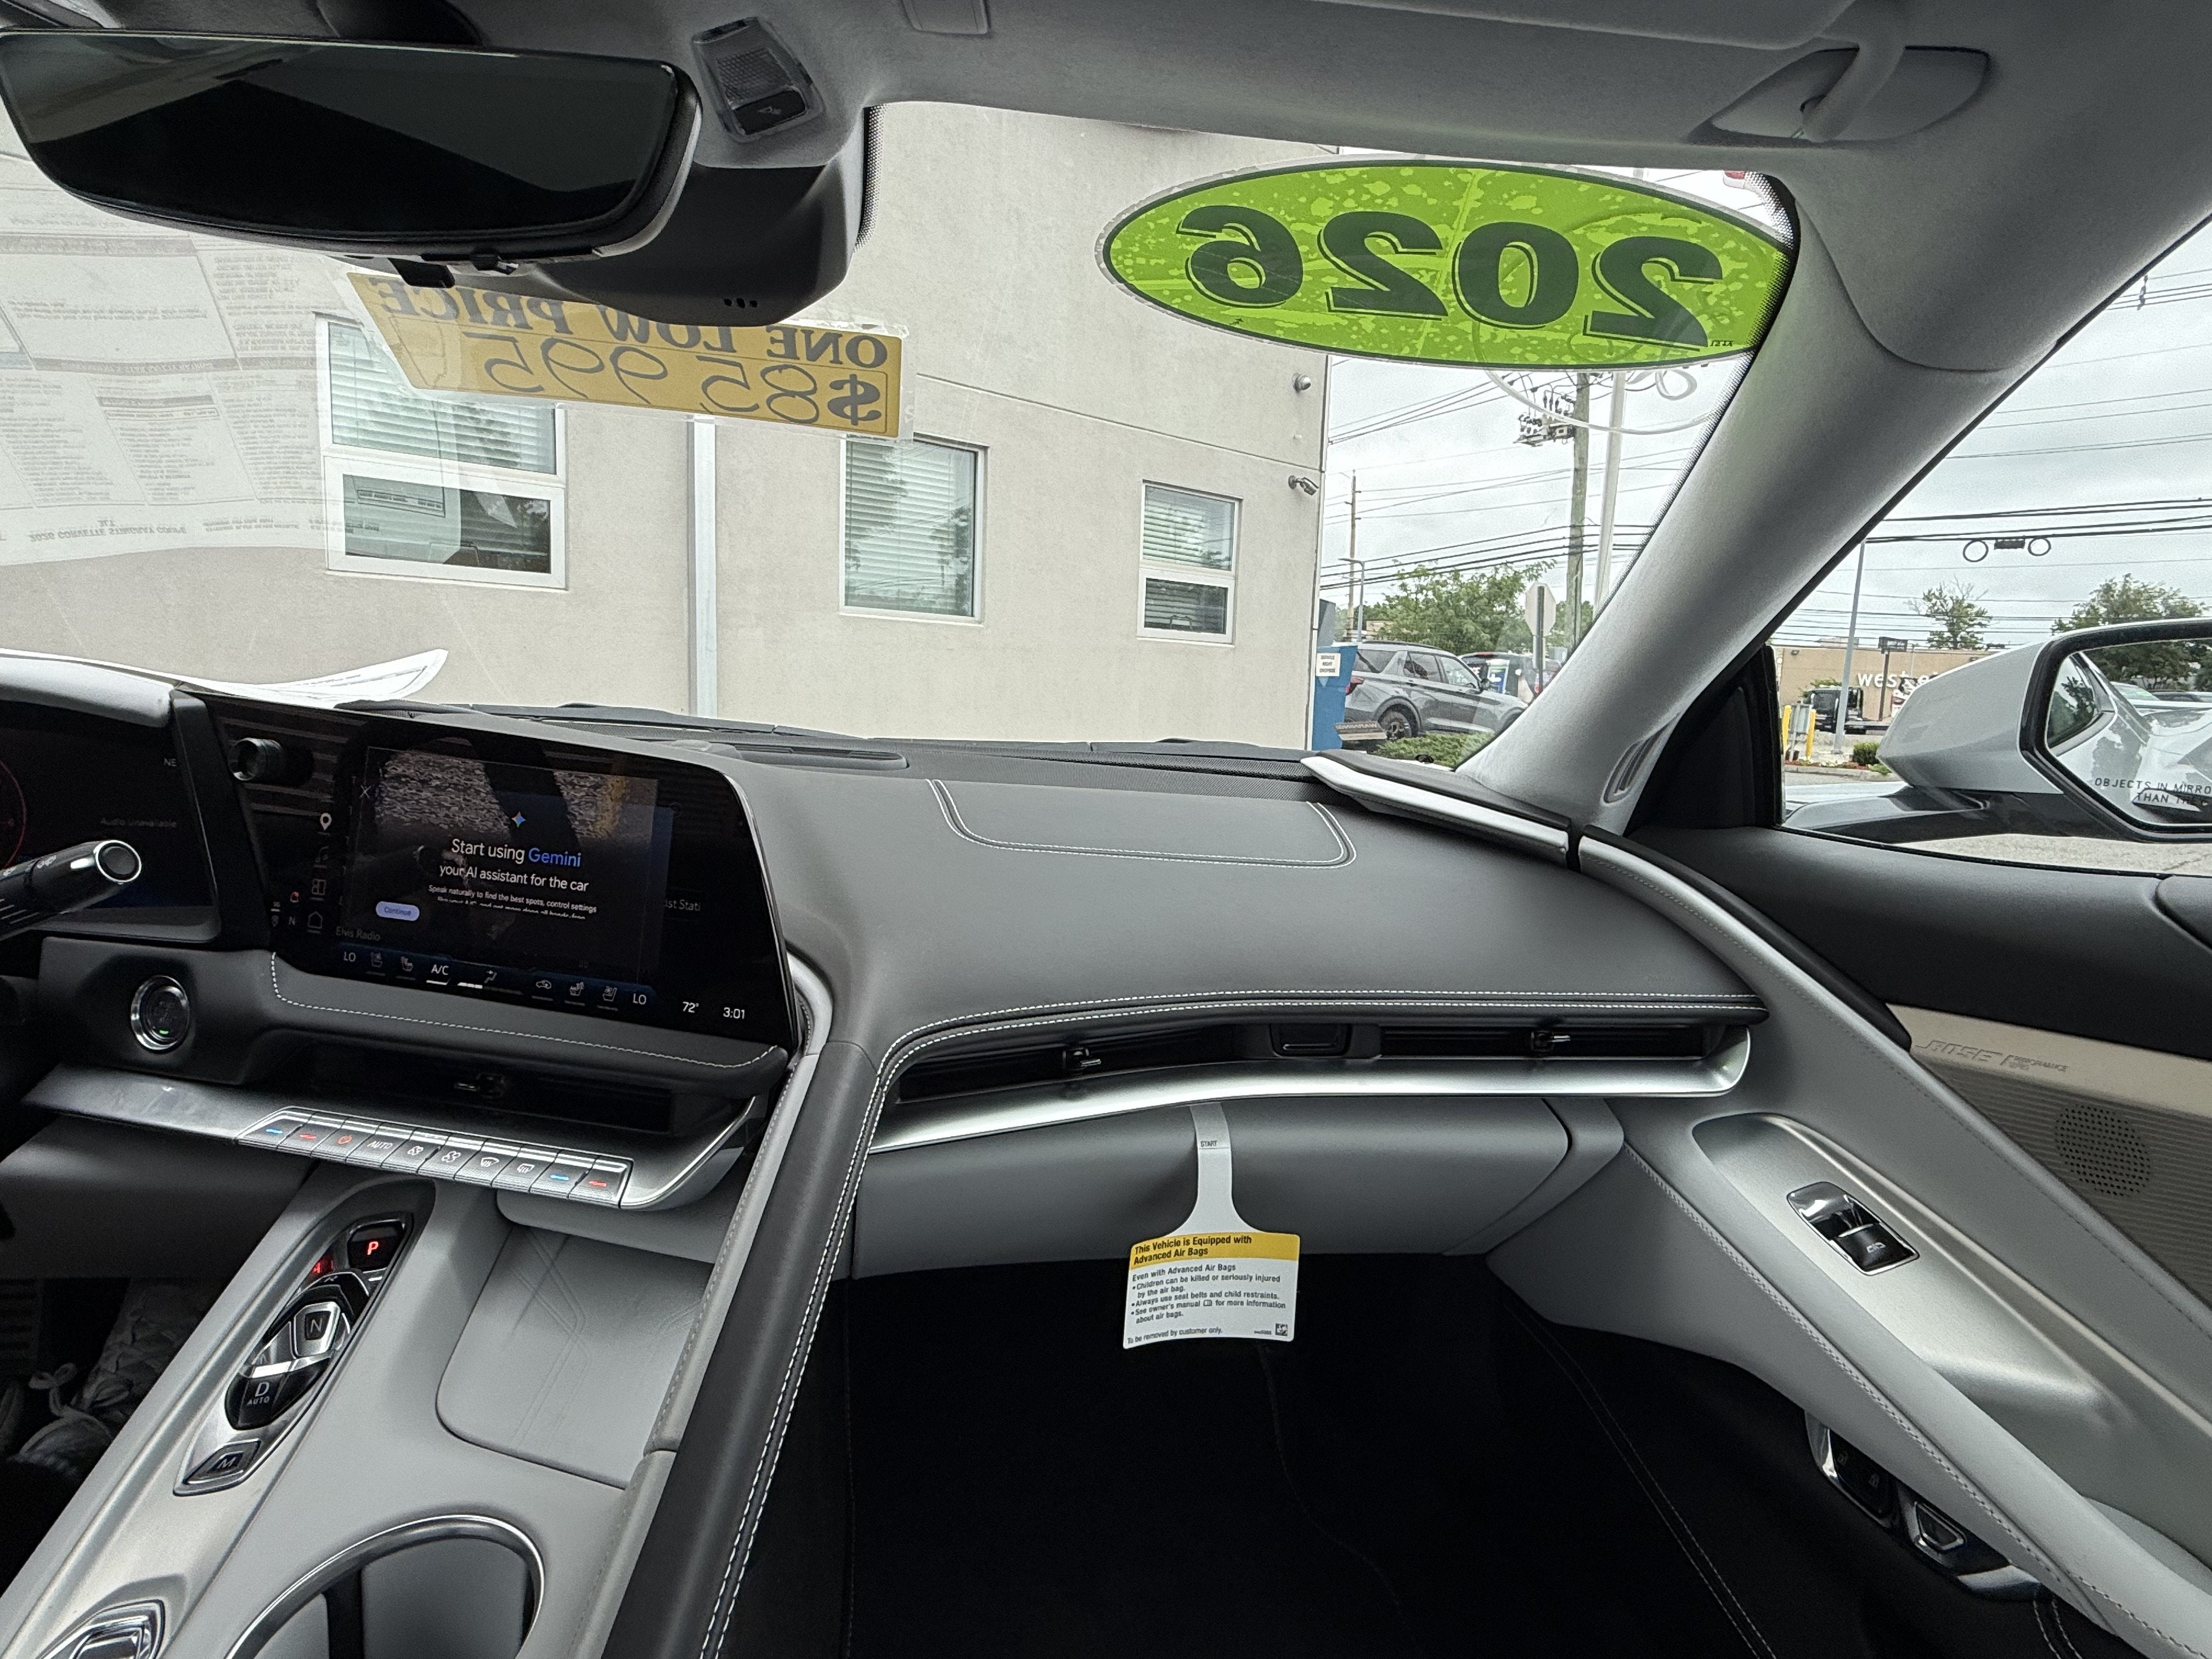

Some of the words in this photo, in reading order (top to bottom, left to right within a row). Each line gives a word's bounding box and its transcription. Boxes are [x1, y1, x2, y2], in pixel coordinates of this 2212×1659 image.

[163, 758, 177, 767] NE
[2095, 777, 2151, 789] OBJECTS
[2158, 782, 2168, 790] IN
[2137, 792, 2169, 803] THAN
[451, 838, 485, 856] Start
[488, 845, 524, 865] using
[528, 847, 582, 868] Gemini
[439, 865, 463, 877] your
[466, 867, 478, 879] AI
[479, 868, 528, 885] assistant
[530, 873, 547, 887] for
[549, 876, 568, 889] the
[569, 881, 589, 893] car
[428, 884, 448, 894] Speak
[448, 887, 476, 898] naturally
[485, 890, 496, 901] find
[498, 891, 508, 902] the
[510, 893, 524, 904] best
[526, 896, 545, 908] spots,
[546, 899, 570, 910] control
[571, 902, 597, 915] settings
[384, 906, 411, 916] Continue
[335, 925, 354, 939] Elvis
[356, 928, 381, 942] Radio
[343, 951, 356, 963] LO
[430, 963, 449, 977] A/C
[632, 992, 647, 1006] LO
[723, 1007, 746, 1020] 3:01
[1915, 1040, 2003, 1063] BOSE
[368, 1137, 393, 1152] AUTO
[366, 1241, 379, 1256] P
[1135, 1245, 1150, 1255] This
[1152, 1238, 1181, 1251] Vehicle
[1183, 1237, 1190, 1246] is
[1193, 1234, 1231, 1247] Equipped
[1233, 1235, 1252, 1244] with
[1134, 1251, 1172, 1265] Advanced
[1174, 1248, 1186, 1257] Air
[1188, 1247, 1209, 1257] Bags
[1132, 1272, 1149, 1282] Even
[1150, 1268, 1165, 1277] with
[1167, 1265, 1203, 1275] Advanced
[1217, 1263, 1236, 1272] Bags
[1136, 1279, 1164, 1290] Children
[1221, 1273, 1253, 1283] seriously
[1255, 1273, 1280, 1283] injured
[1171, 1284, 1186, 1293] bag.
[1136, 1298, 1158, 1307] Always
[1224, 1290, 1242, 1298] child
[1243, 1291, 1279, 1300] restraints.
[1149, 1302, 1174, 1312] owner's
[1176, 1300, 1201, 1308] manual
[1246, 1299, 1286, 1309] information
[1136, 1314, 1154, 1324] about
[1166, 1310, 1184, 1318] bags.
[309, 1318, 323, 1333] N
[1143, 1330, 1169, 1340] removed
[1209, 1327, 1223, 1335] only.
[255, 1382, 269, 1397] D
[247, 1396, 270, 1406] AUTO
[218, 1457, 236, 1469] M
